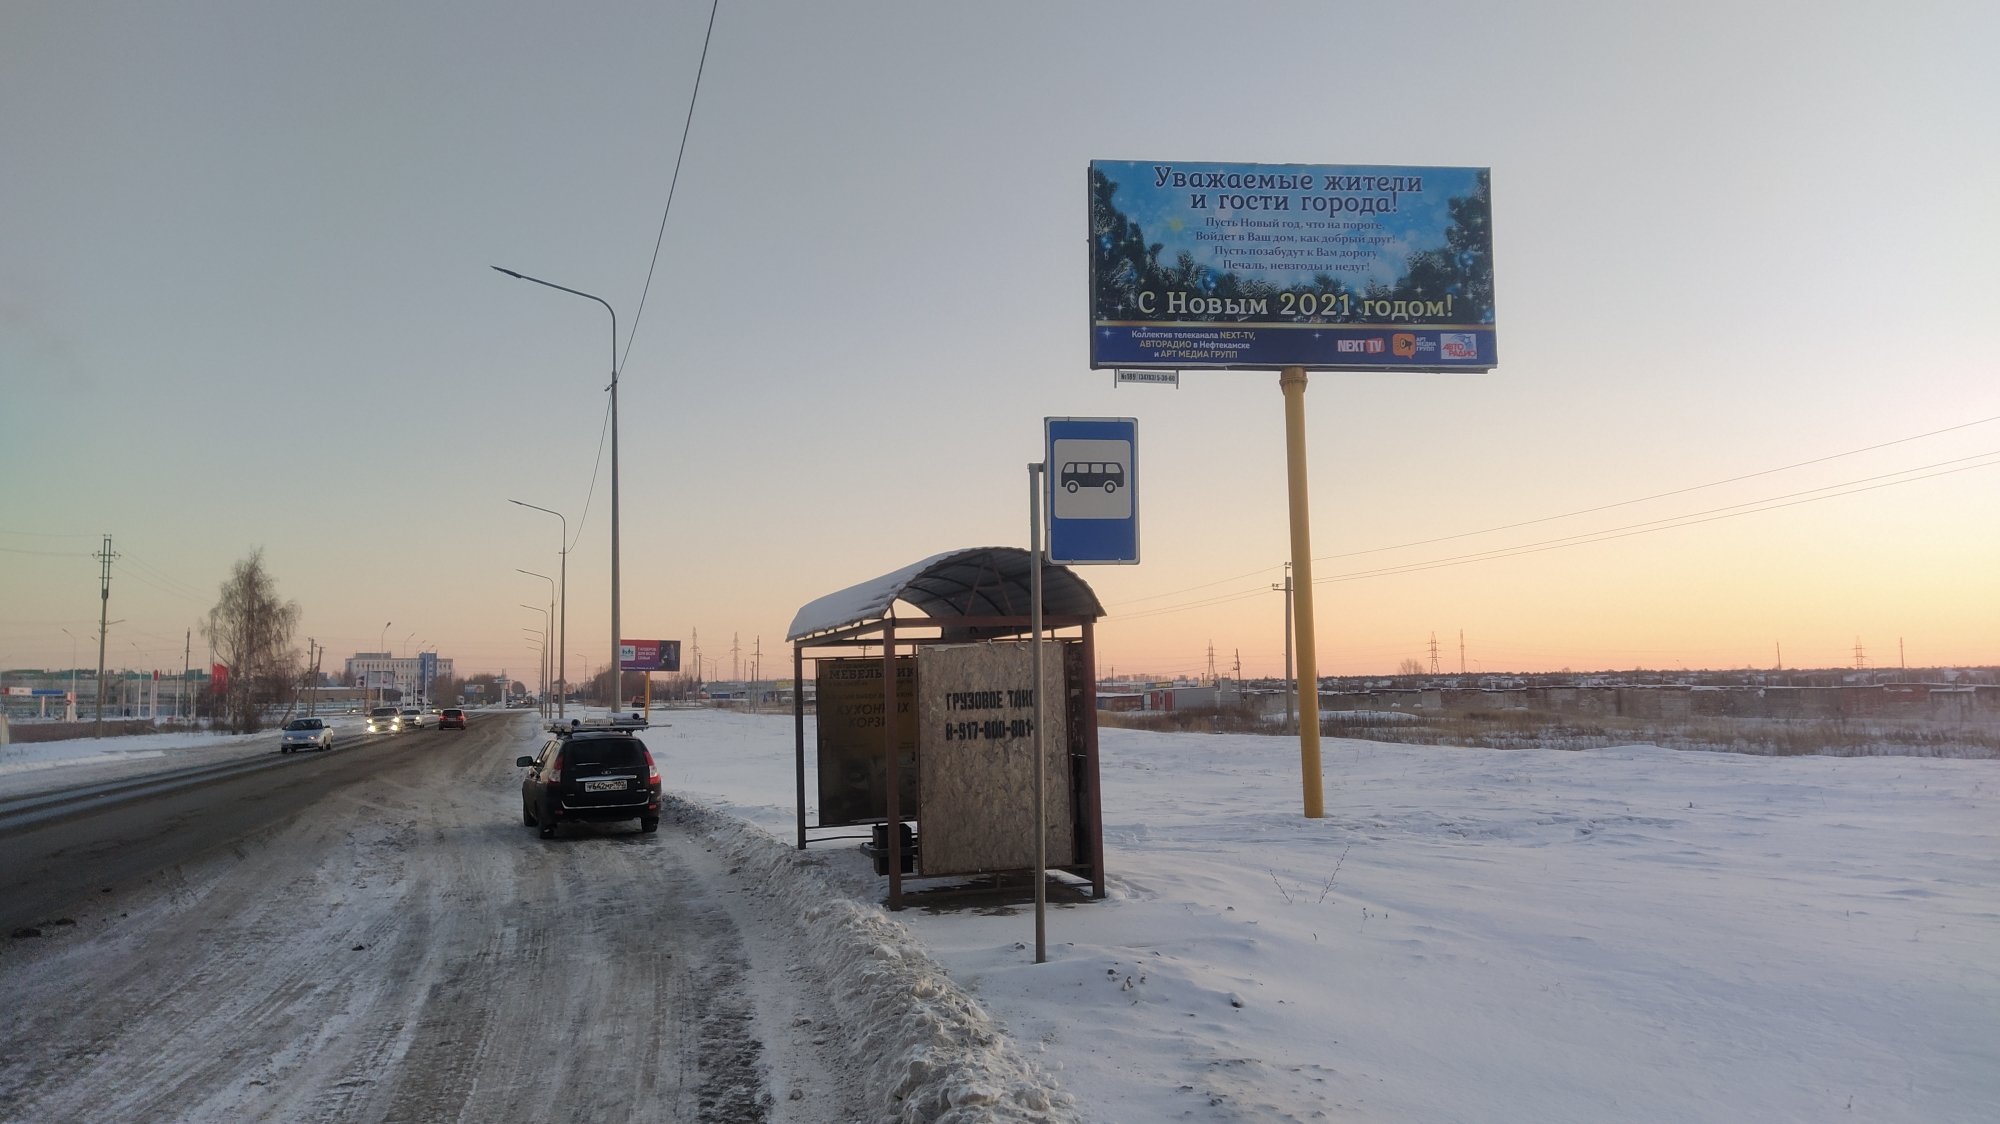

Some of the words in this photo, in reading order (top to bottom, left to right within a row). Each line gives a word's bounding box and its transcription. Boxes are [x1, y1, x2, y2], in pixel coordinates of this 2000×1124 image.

[1154, 166, 1313, 190] Уважаемые
[1324, 175, 1423, 192] жители
[1190, 194, 1207, 209] и
[1219, 194, 1290, 211] гости
[1301, 191, 1398, 218] города!
[1205, 217, 1238, 228] Пусть
[1240, 217, 1280, 228] Новый
[1305, 221, 1325, 229] что
[1327, 221, 1341, 229] на
[1196, 231, 1237, 242] Войдет
[1247, 232, 1271, 242] Ваш
[1272, 235, 1298, 243] дом,
[1300, 235, 1320, 243] как
[1322, 233, 1365, 246] добрый
[1367, 234, 1396, 246] друг!
[1214, 246, 1247, 257] Пусть
[1248, 247, 1305, 258] позабудут
[1307, 249, 1314, 257] к
[1316, 247, 1338, 257] Вам
[1339, 249, 1377, 260] дорогу
[1223, 260, 1268, 271] Печаль,
[1270, 262, 1323, 272] невзгоды
[1335, 262, 1370, 273] недуг!
[1138, 290, 1156, 314] С
[1167, 291, 1269, 315] Новым
[1280, 293, 1350, 316] 2021
[1363, 294, 1453, 321] годом!
[1131, 330, 1173, 339] Коллектив
[1174, 331, 1218, 339] телеканала
[1220, 331, 1256, 341] NEXT-TV,
[1140, 340, 1192, 349] АВТОРАДИО
[1199, 341, 1251, 350] Нефтекамске
[1337, 340, 1365, 352] NEXT
[1367, 340, 1382, 352] TV
[1160, 350, 1177, 358] АРТ
[1178, 350, 1210, 359] МЕДИА
[1210, 350, 1238, 358] ГРУПП
[829, 667, 914, 680] МЕБЕЛЬИК
[946, 690, 1003, 711] ГРУЗОВОЕ
[1007, 689, 1034, 708] ТАКС
